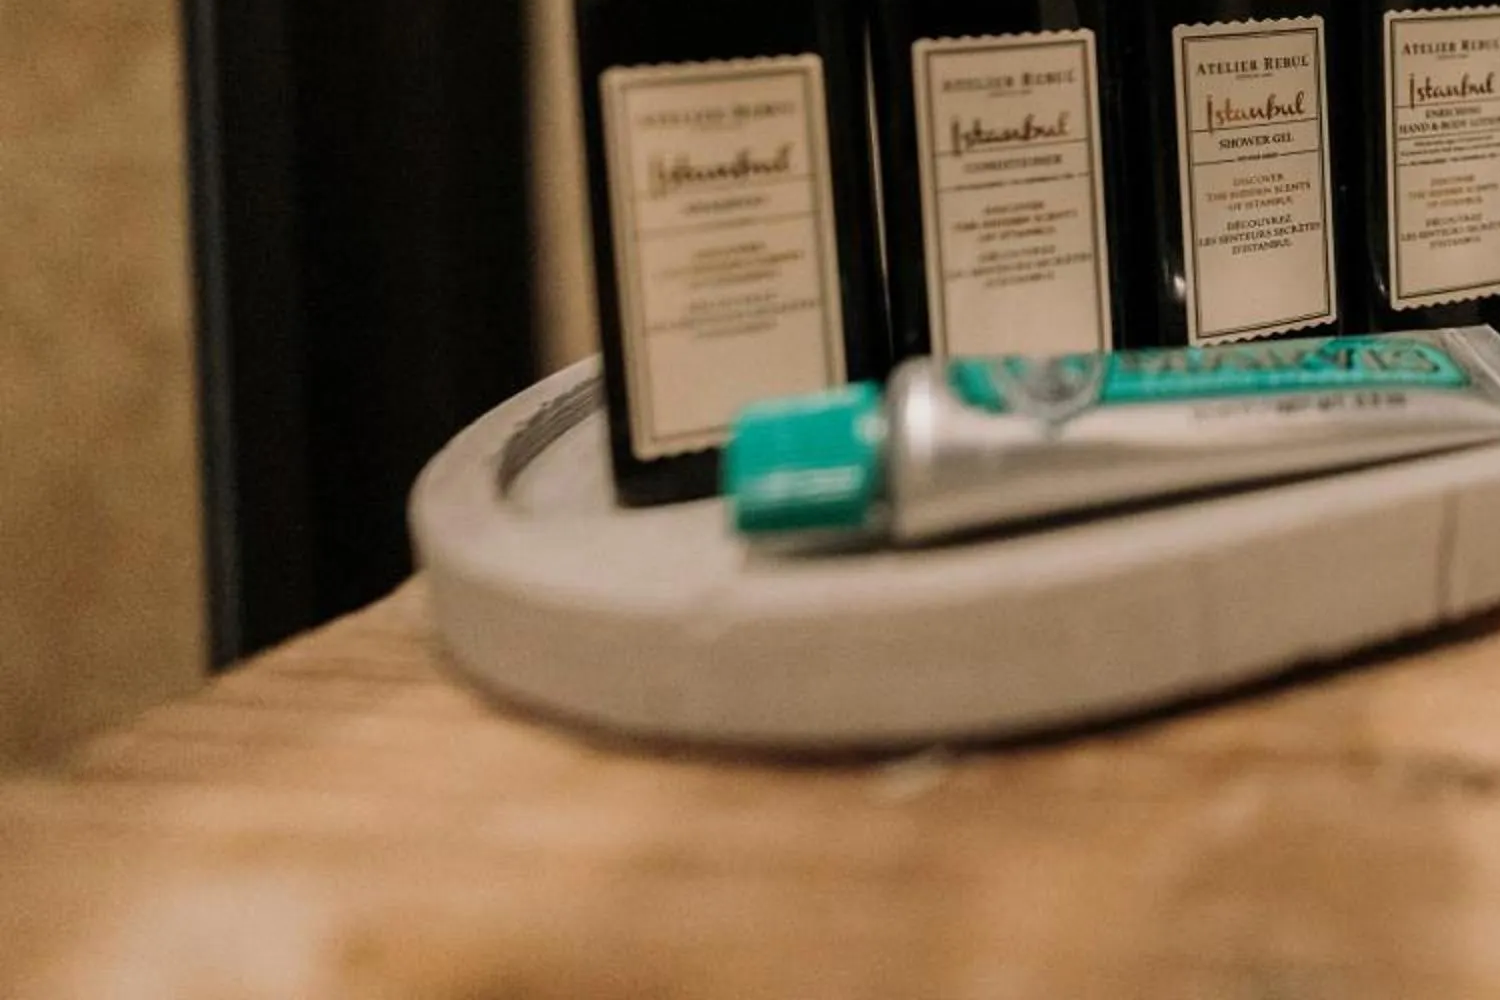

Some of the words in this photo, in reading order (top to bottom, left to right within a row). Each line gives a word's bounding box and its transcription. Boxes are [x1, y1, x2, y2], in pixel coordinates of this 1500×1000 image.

[1195, 60, 1258, 76] ATELIER
[1264, 55, 1310, 71] REBUL
[1218, 136, 1270, 150] SHOWER
[1271, 132, 1295, 144] GEL
